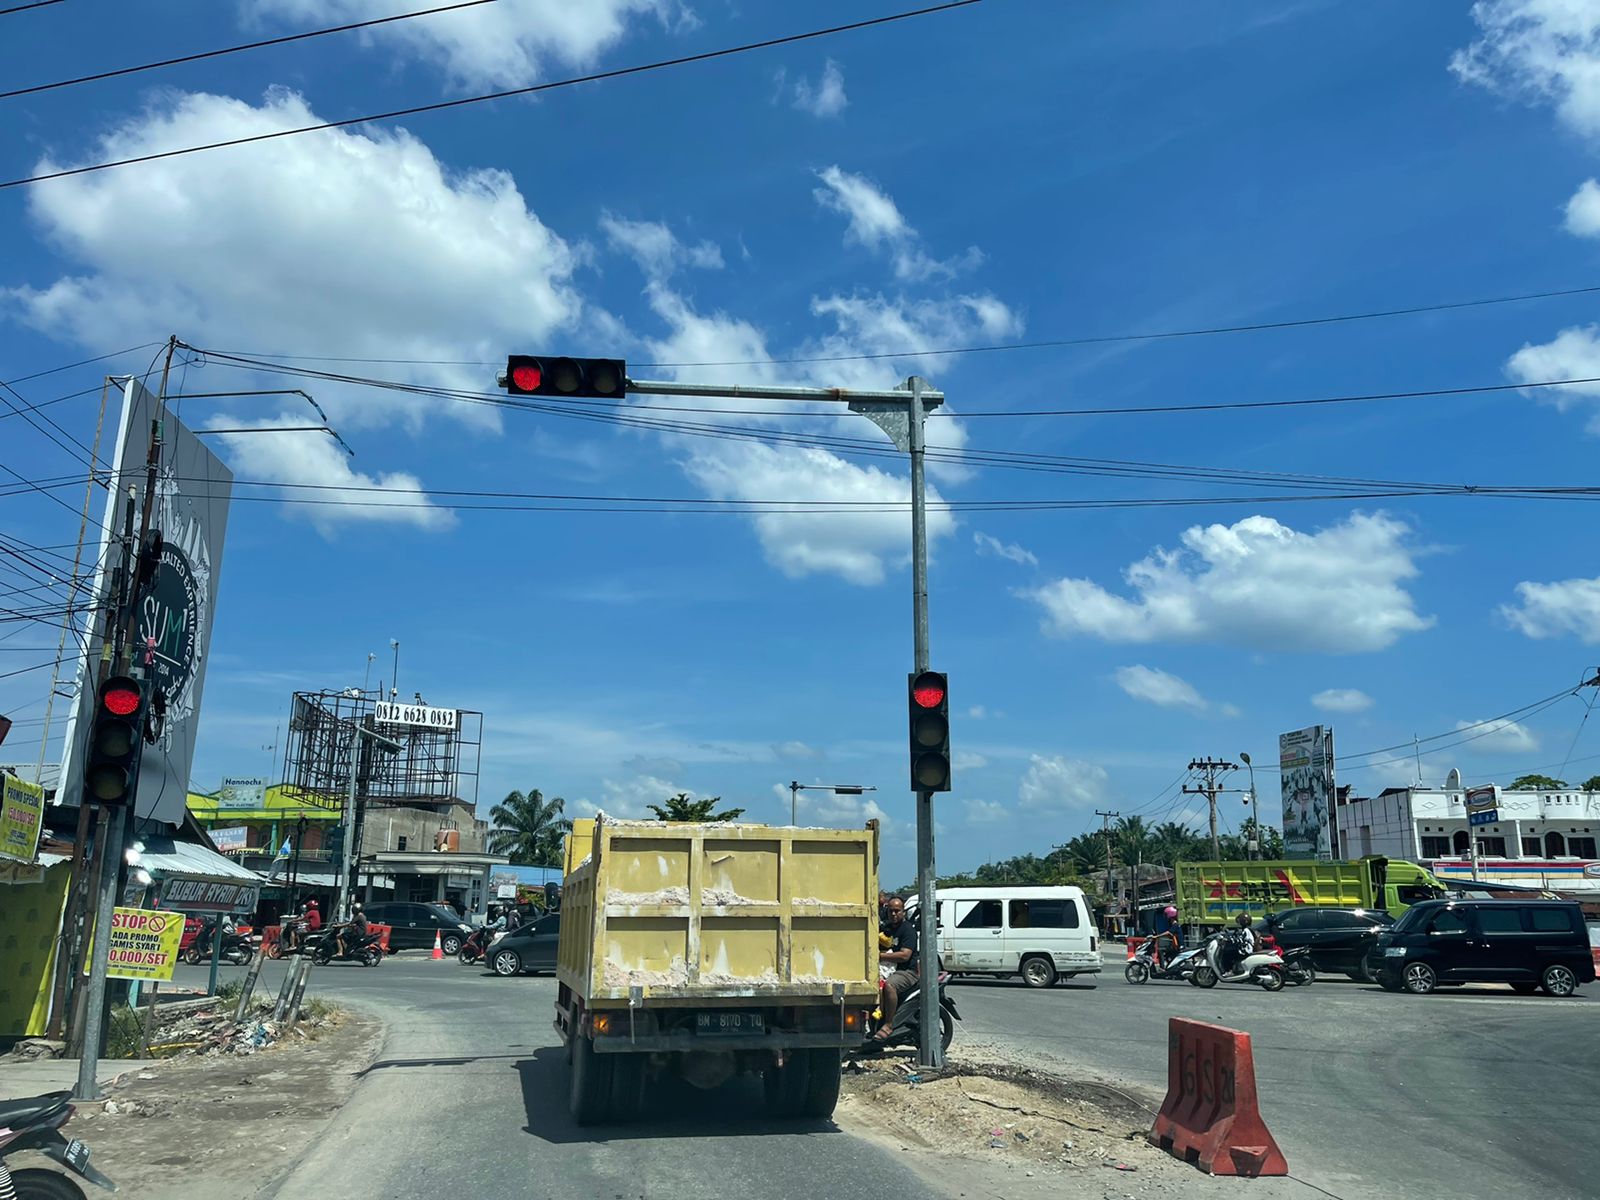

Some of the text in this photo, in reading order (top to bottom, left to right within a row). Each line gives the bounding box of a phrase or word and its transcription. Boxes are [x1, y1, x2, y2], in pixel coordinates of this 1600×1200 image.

[161, 551, 185, 577] XALTED
[376, 704, 453, 726] 0812 6628 0882
[166, 880, 208, 901] BUBUR
[204, 883, 239, 904] AYAM
[112, 913, 147, 929] STOP
[112, 931, 159, 942] ADA PROMO
